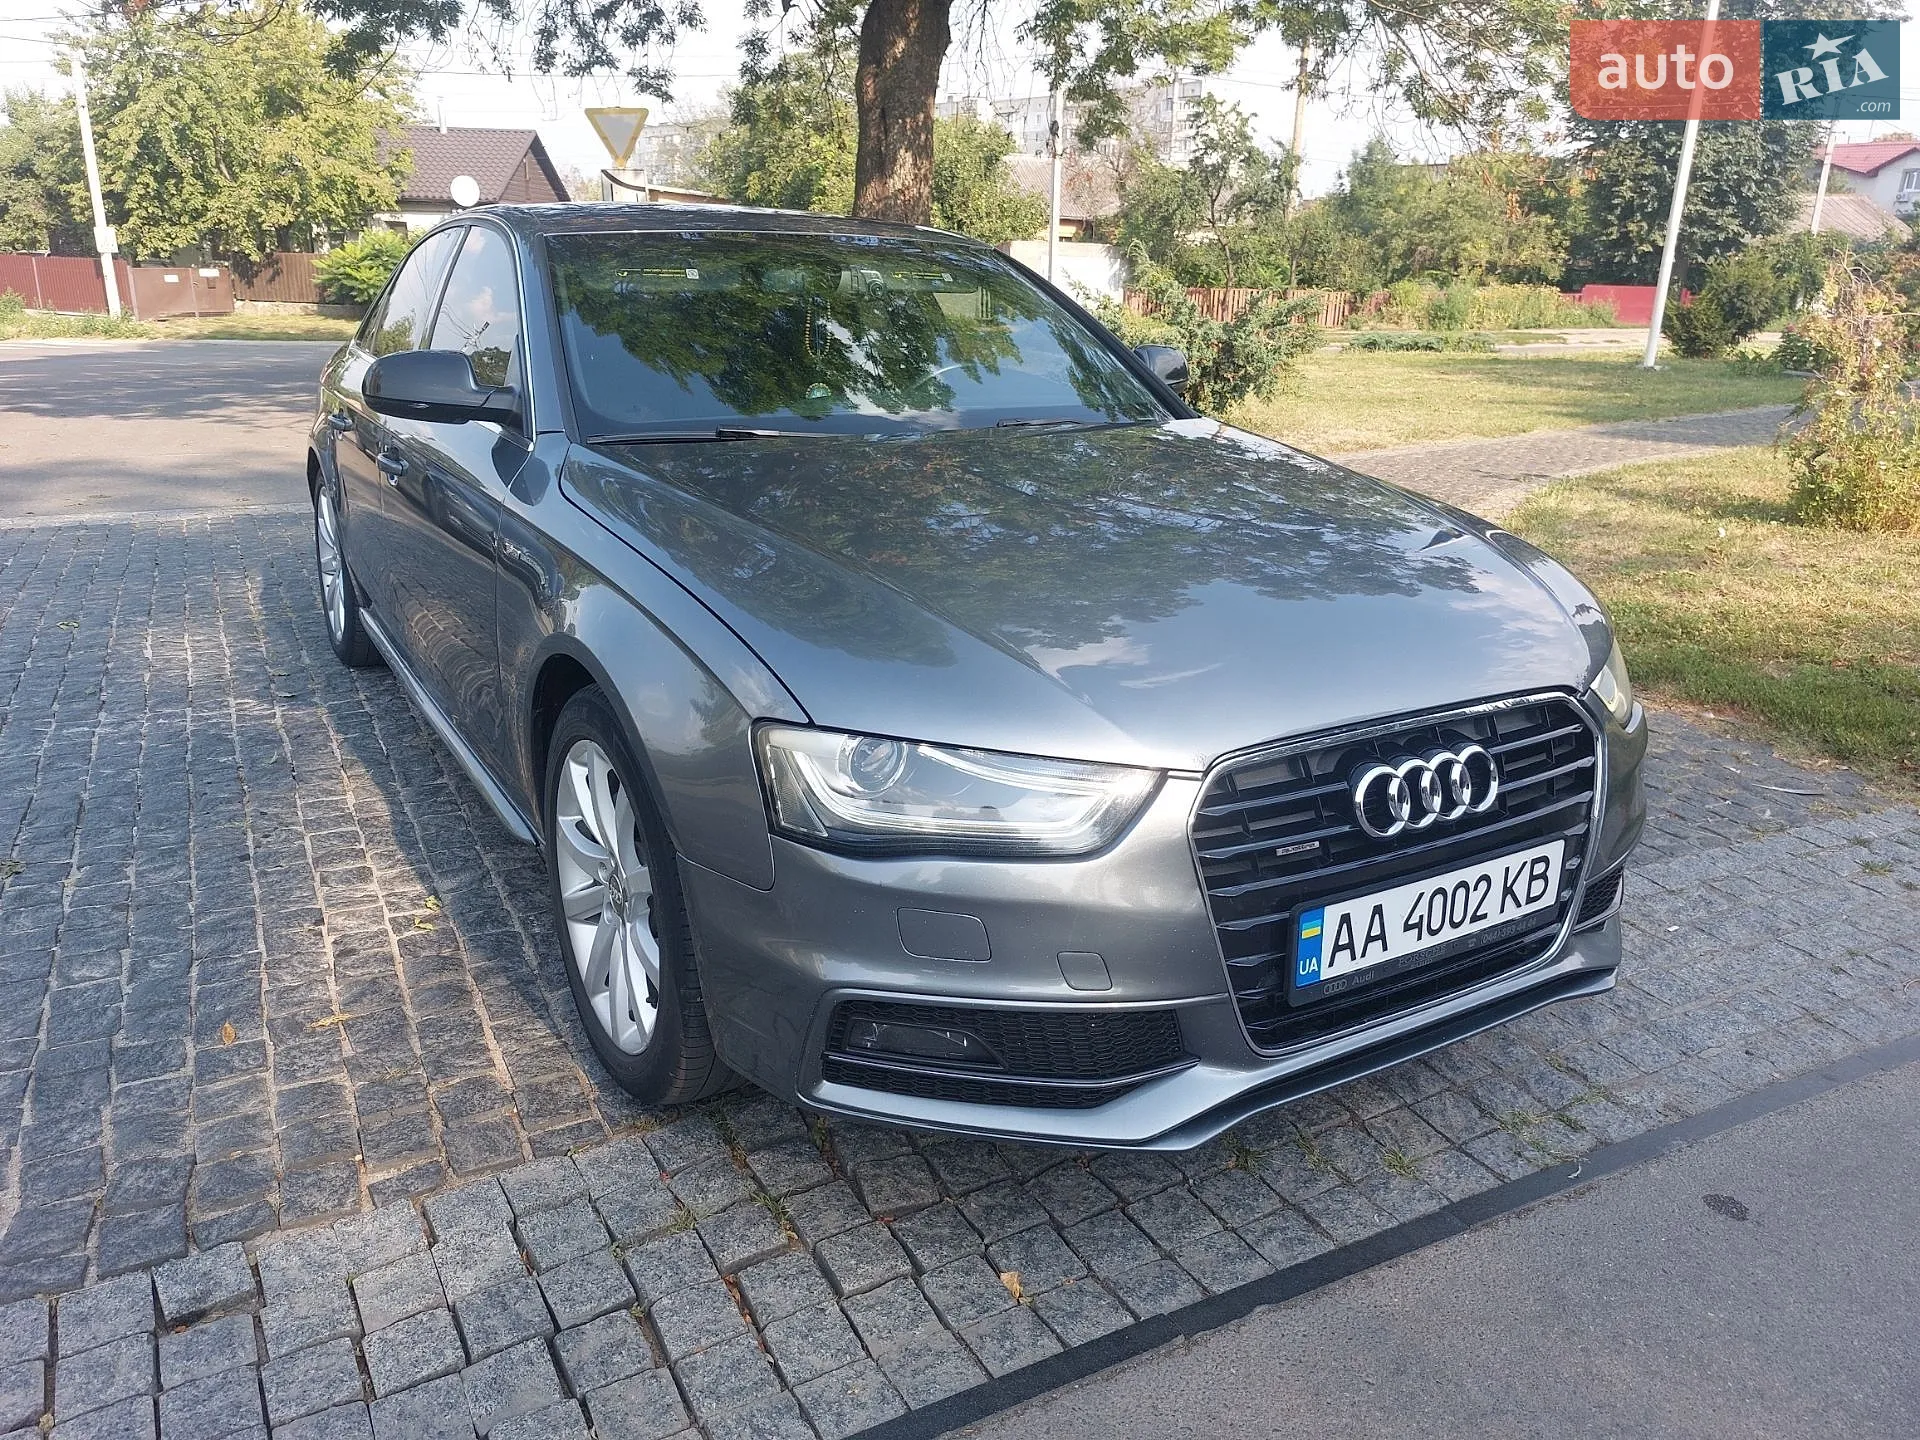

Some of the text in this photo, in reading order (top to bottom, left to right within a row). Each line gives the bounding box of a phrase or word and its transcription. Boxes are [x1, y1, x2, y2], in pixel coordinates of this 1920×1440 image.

[1328, 855, 1550, 969] AA 4002 KB
[1299, 960, 1319, 976] UA
[1352, 970, 1375, 986] Audi
